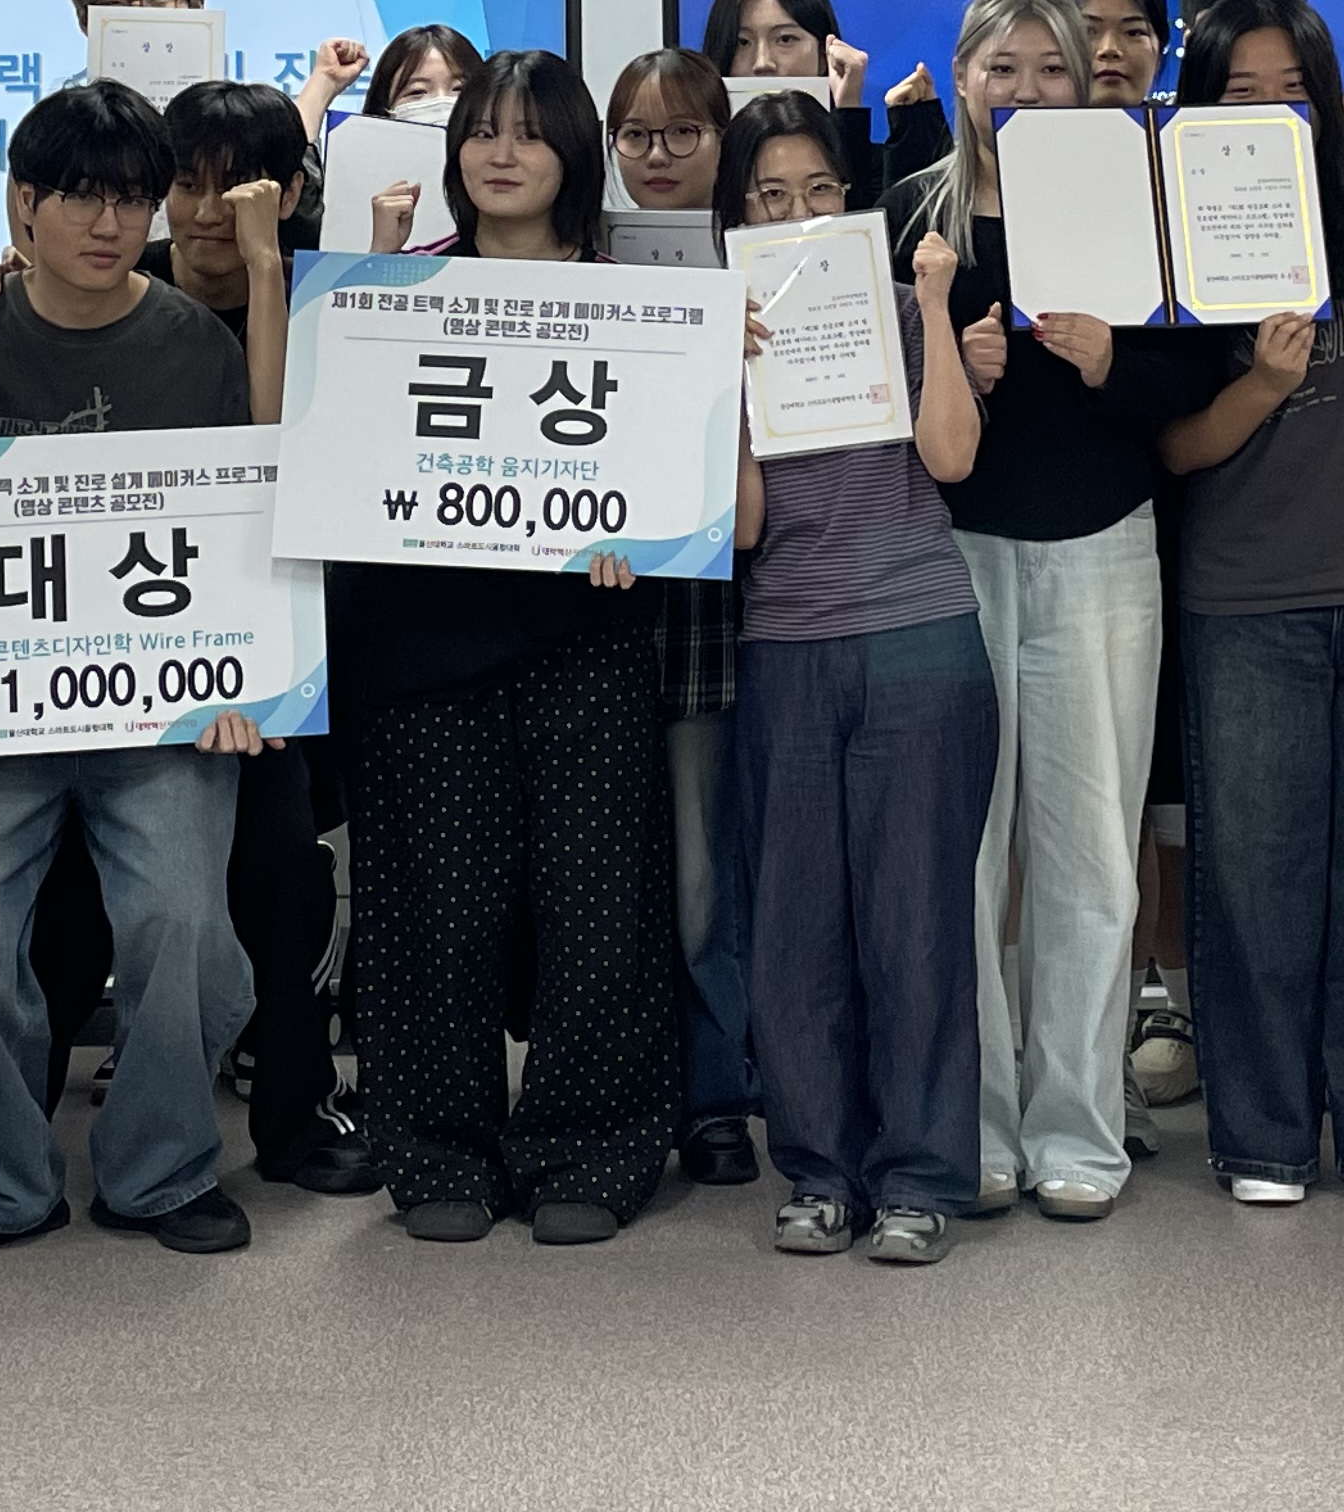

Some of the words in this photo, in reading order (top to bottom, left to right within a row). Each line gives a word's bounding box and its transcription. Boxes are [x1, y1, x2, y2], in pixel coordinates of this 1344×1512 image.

[332, 292, 373, 310] 제1회
[377, 294, 409, 311] 전공
[413, 296, 444, 313] 트랙
[448, 297, 479, 314] 소개
[485, 298, 499, 315] 및
[504, 299, 534, 317] 진로
[539, 301, 569, 319] 설계
[574, 302, 637, 321] 메이커스
[641, 305, 704, 325] 프로그램
[485, 319, 532, 339] 콘텐츠
[536, 321, 590, 342] 공모전)
[408, 354, 493, 440] 금
[529, 360, 618, 446] 상
[18, 477, 49, 495] 소개
[55, 475, 69, 493] 및
[74, 474, 105, 491] 진로
[111, 472, 143, 490] 설계
[147, 469, 212, 488] 메이커스
[216, 465, 278, 484] 프로그램
[416, 453, 495, 476] 건축공학
[500, 456, 600, 482] 움지기자단
[57, 495, 105, 514] 콘텐츠
[110, 492, 165, 512] 공모전)
[437, 482, 627, 538] 800,000
[108, 527, 199, 617] 상
[139, 631, 186, 651] Wire
[192, 629, 255, 648] Frame
[1, 656, 244, 721] 1,000,000
